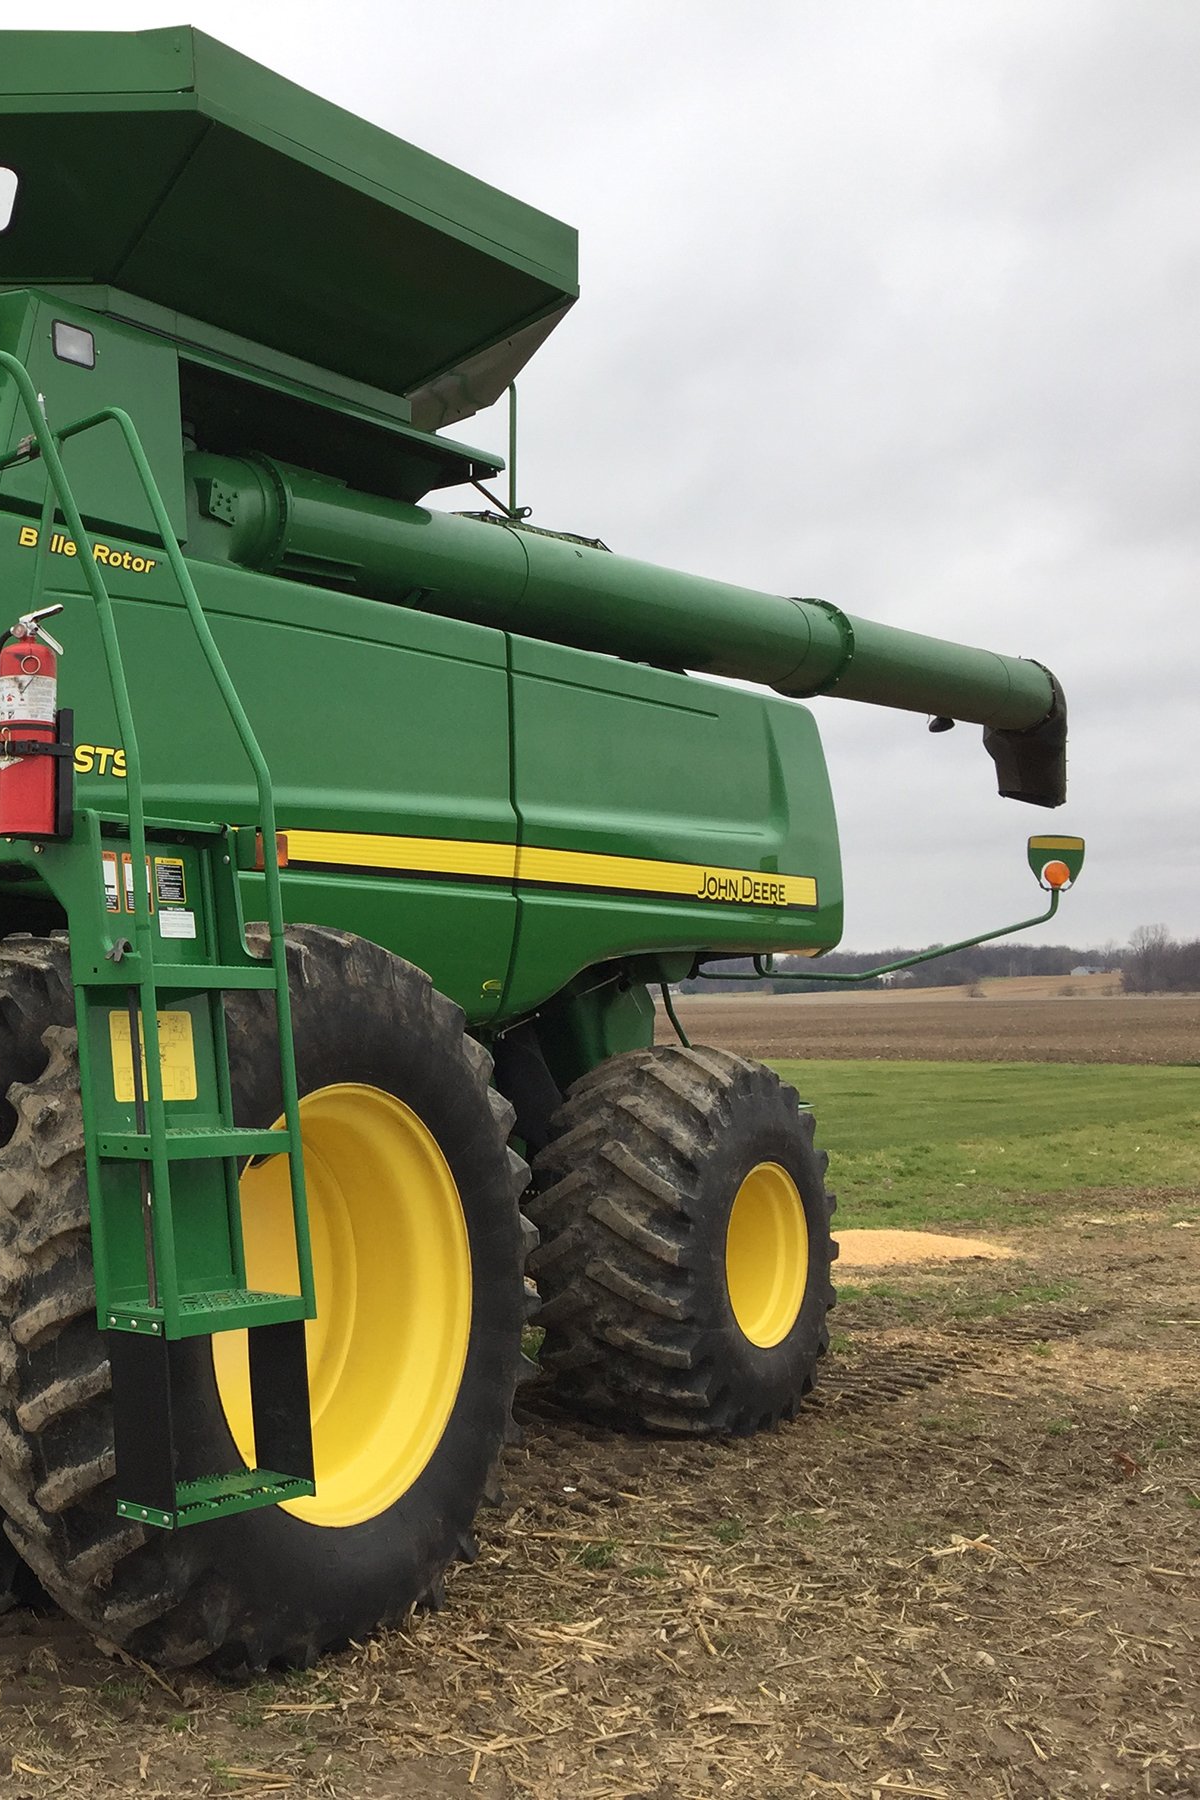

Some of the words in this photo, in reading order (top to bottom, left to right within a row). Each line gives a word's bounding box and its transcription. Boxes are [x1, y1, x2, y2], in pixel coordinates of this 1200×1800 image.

[19, 526, 78, 557] Blle
[93, 543, 156, 574] Rotor
[72, 744, 127, 777] STS
[698, 872, 738, 898] JOHN
[742, 876, 786, 903] DEERE
